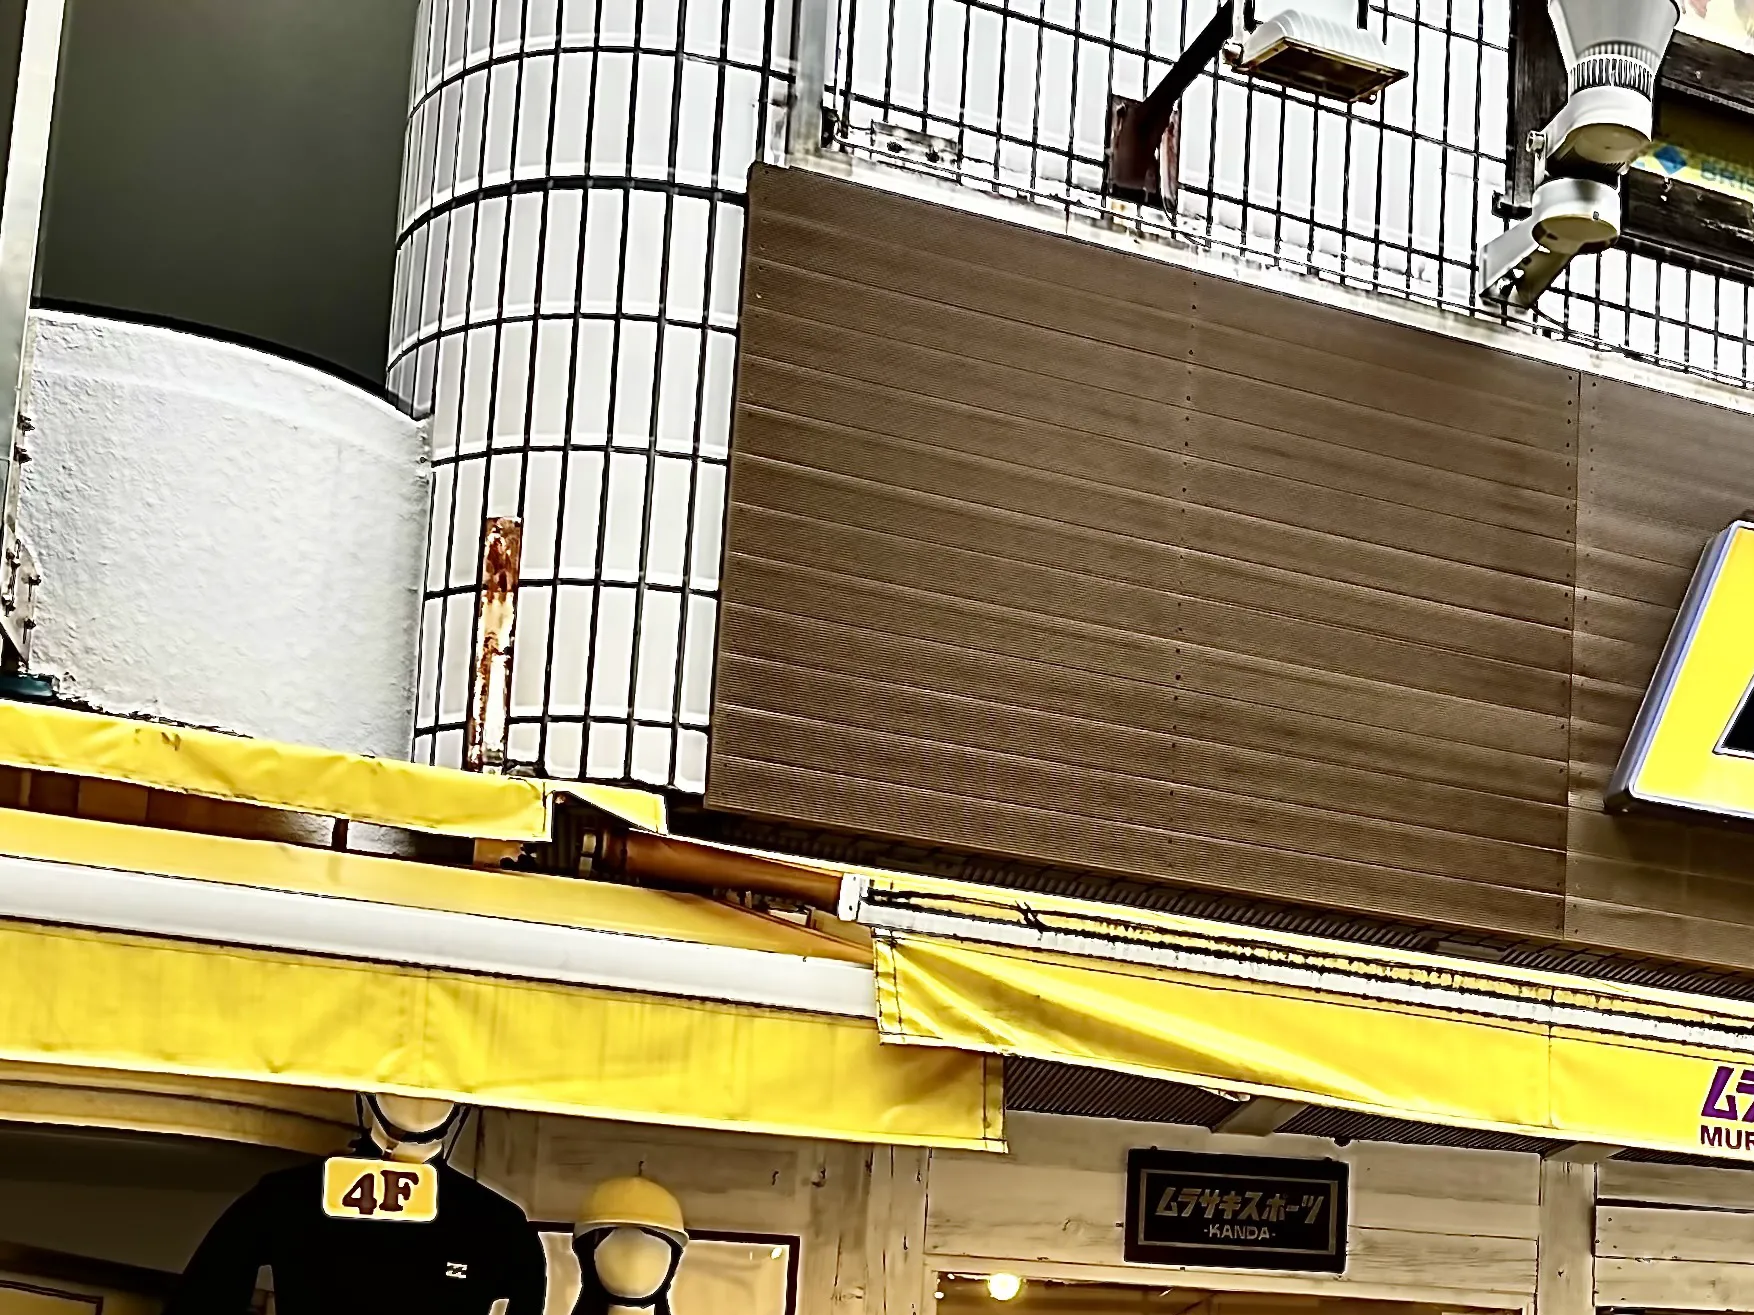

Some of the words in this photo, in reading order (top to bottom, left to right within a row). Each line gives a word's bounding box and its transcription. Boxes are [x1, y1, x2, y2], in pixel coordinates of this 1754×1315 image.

[341, 1168, 420, 1216] 4F
[1154, 1186, 1326, 1225] ムラサキスポーツ
